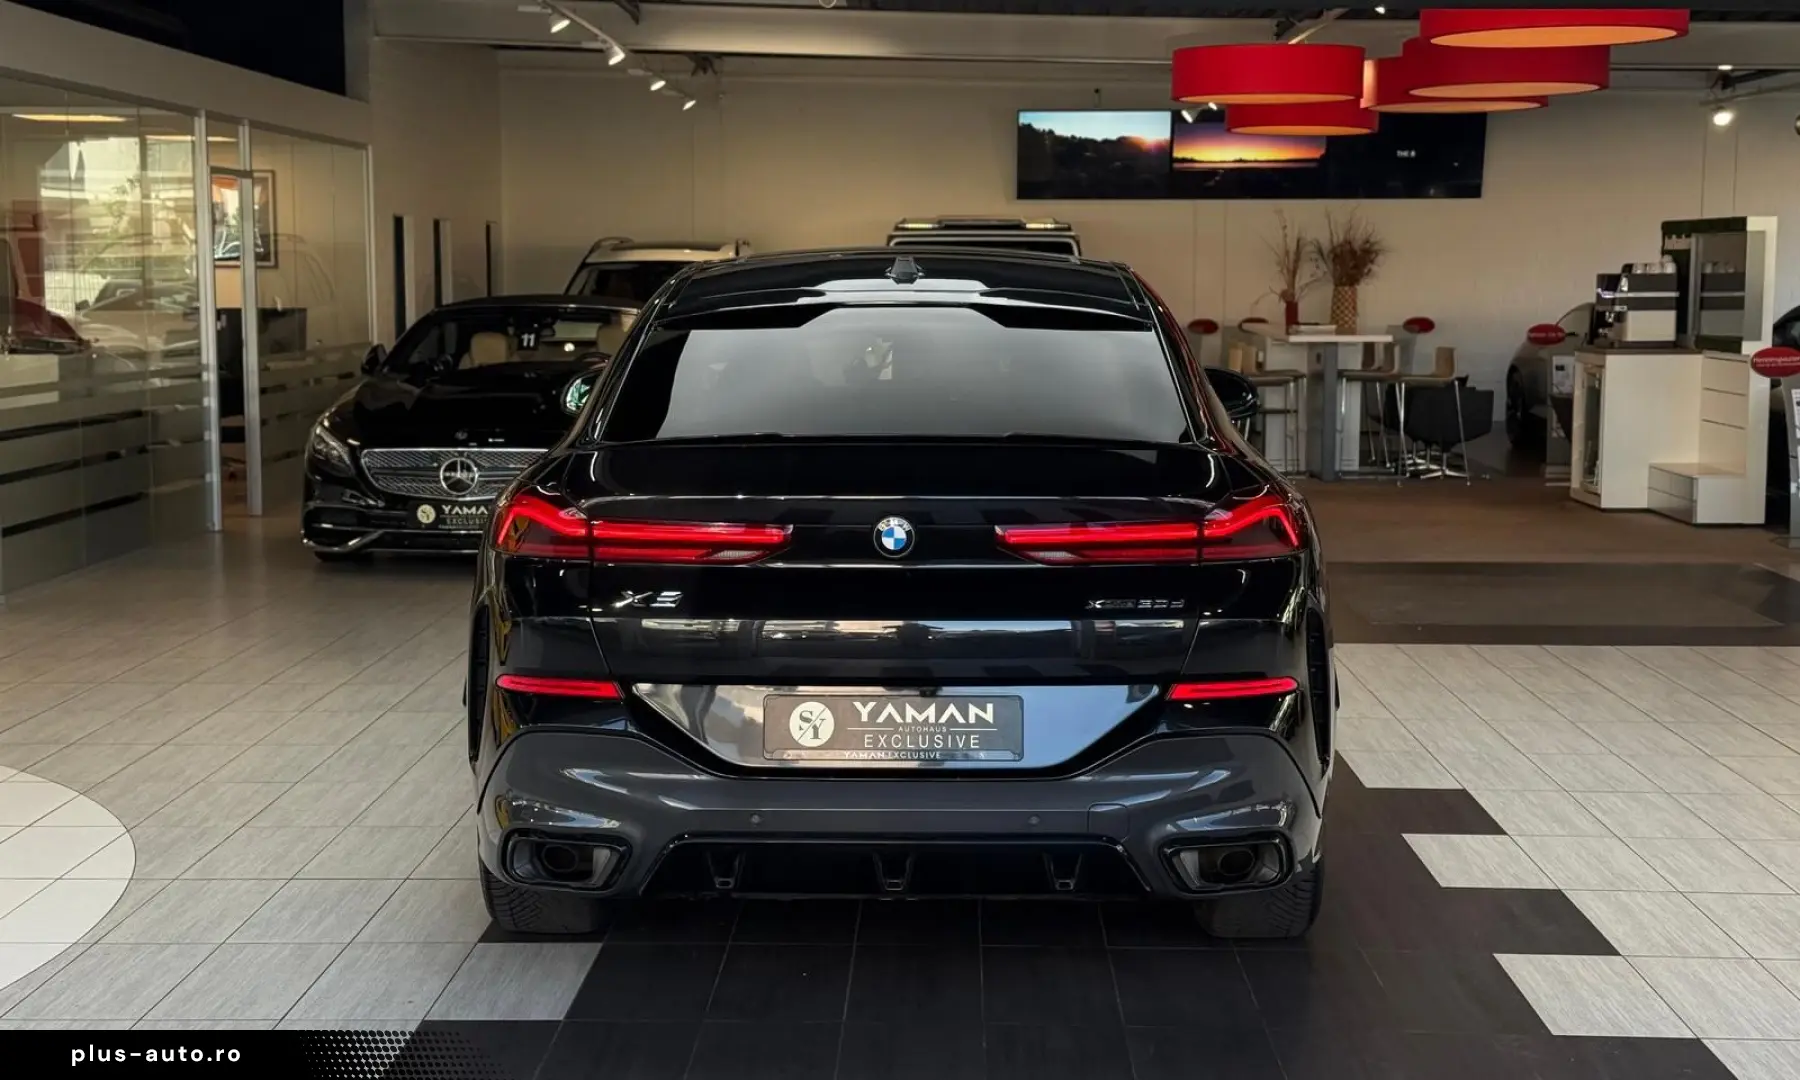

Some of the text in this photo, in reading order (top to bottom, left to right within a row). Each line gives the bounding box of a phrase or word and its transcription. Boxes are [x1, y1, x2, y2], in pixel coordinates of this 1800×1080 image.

[521, 332, 536, 347] 11
[441, 504, 492, 515] YAMA
[852, 701, 994, 724] YAMAN
[864, 734, 980, 749] EXCLUSIVE
[844, 751, 941, 759] YAMAN EXCLUSIVE
